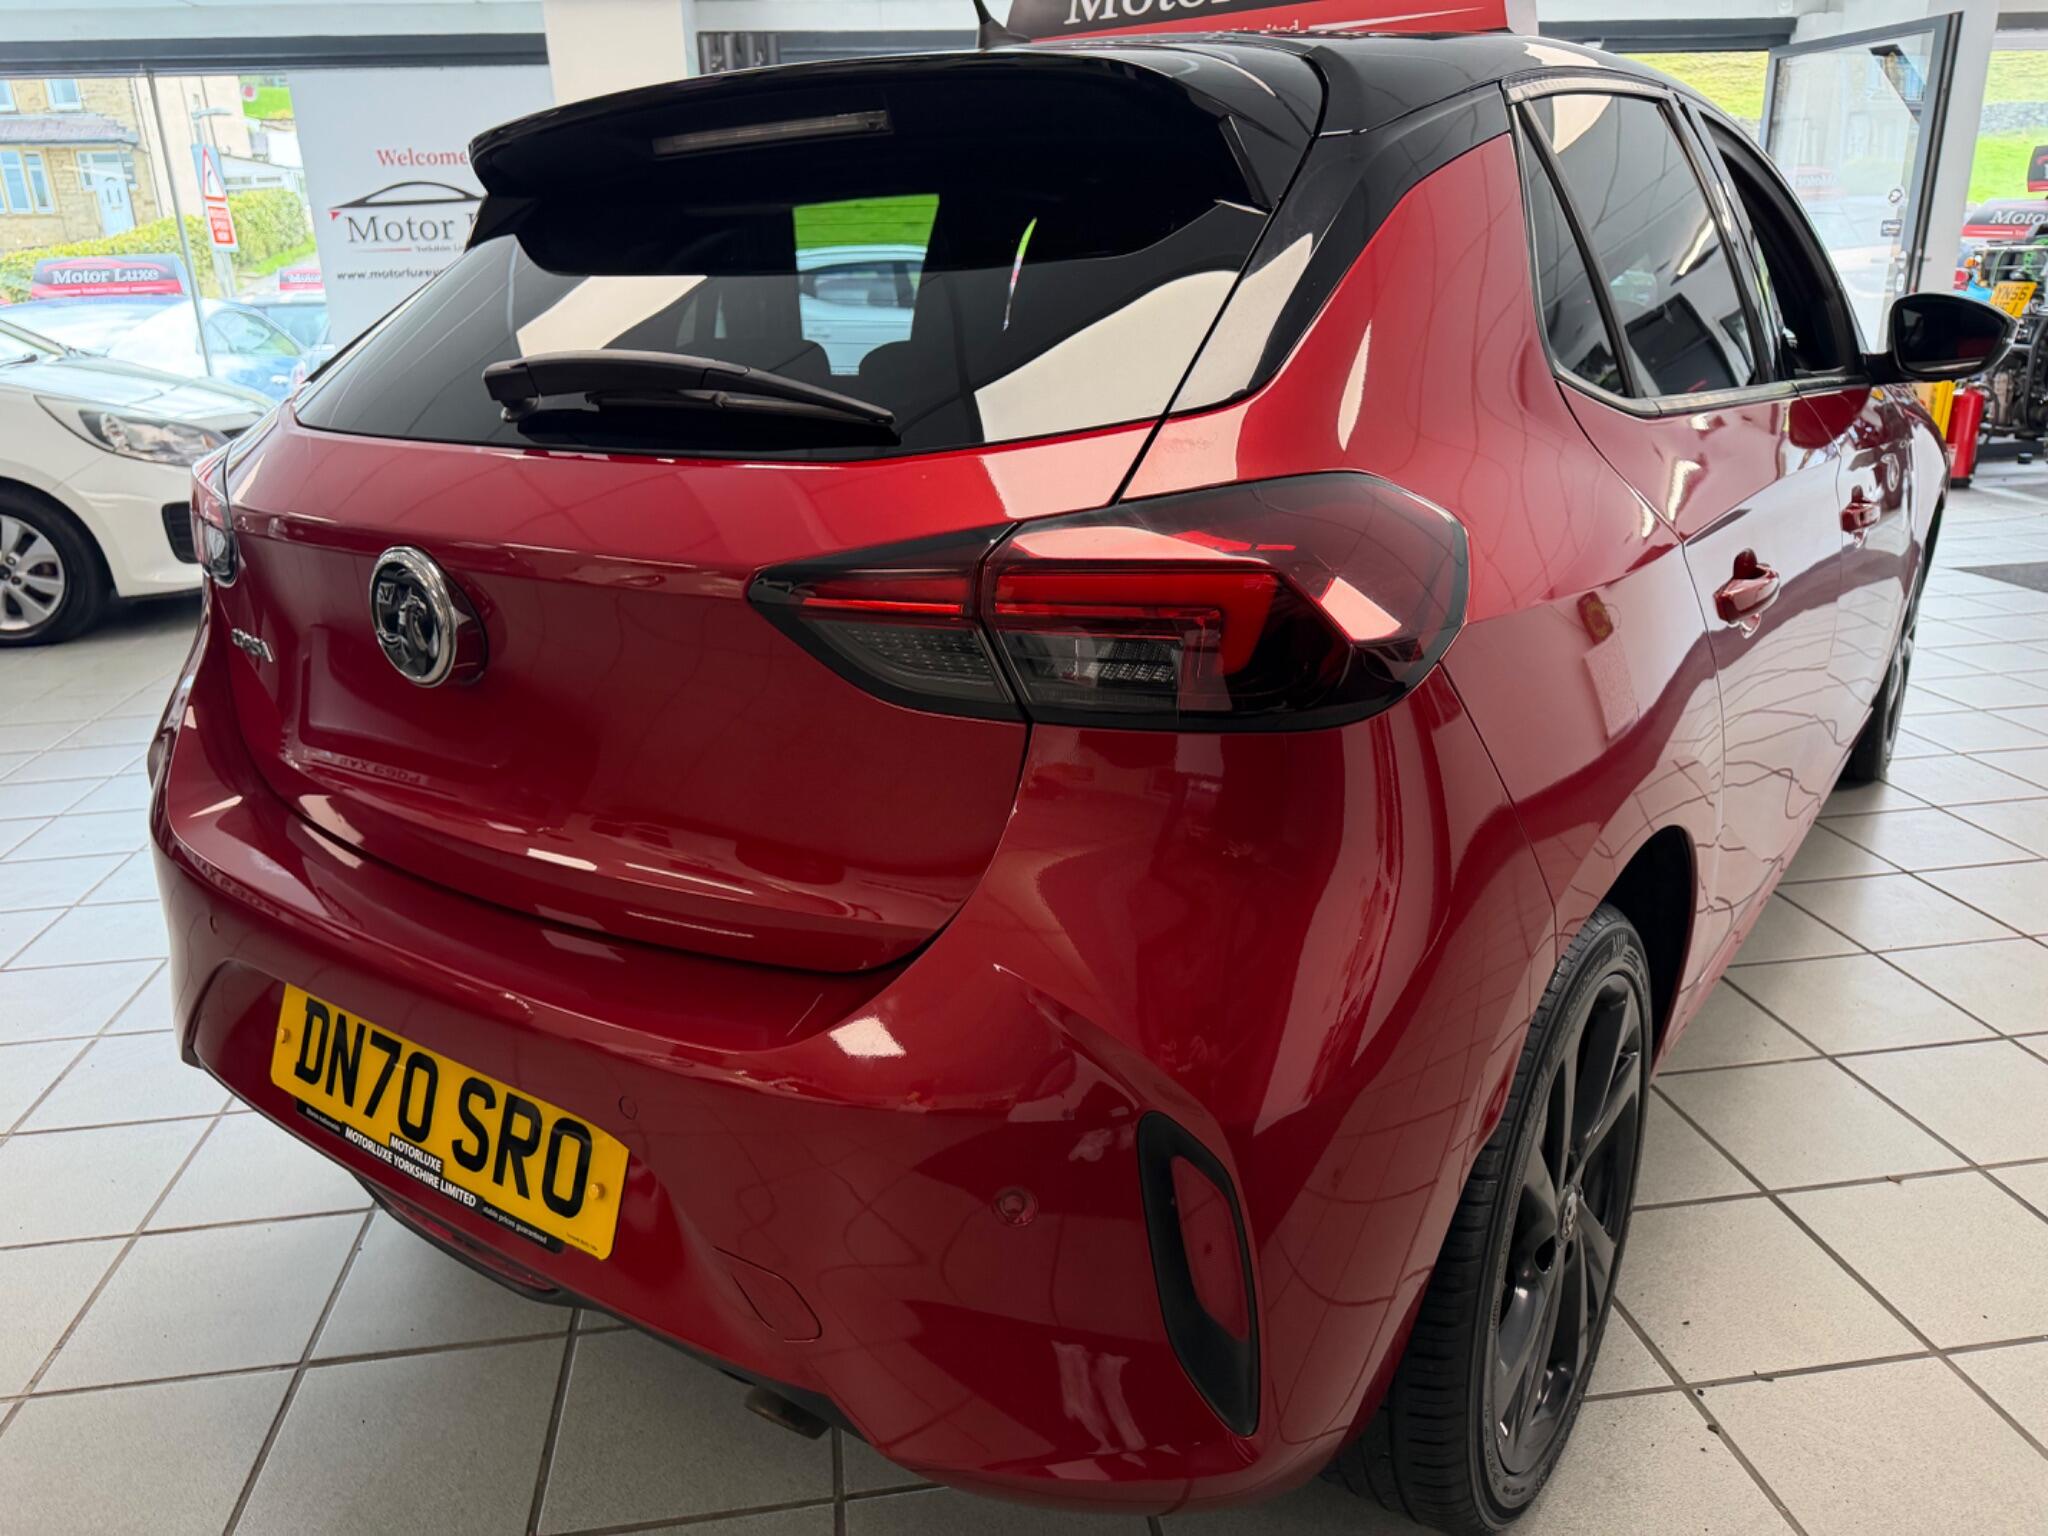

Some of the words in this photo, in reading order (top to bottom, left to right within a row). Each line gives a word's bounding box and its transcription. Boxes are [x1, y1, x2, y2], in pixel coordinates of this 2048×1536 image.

[376, 147, 468, 167] Welcome
[345, 214, 455, 243] Motor
[1989, 210, 2048, 225] Moto
[52, 269, 110, 285] Motor
[114, 268, 160, 283] Luxe
[294, 996, 439, 1144] DN70
[452, 1076, 593, 1219] SRO
[344, 1126, 393, 1164] MOTORLUXE
[393, 1154, 440, 1189] YORKSHIRE
[440, 1178, 477, 1208] LIMITED
[390, 1135, 443, 1173] MOTORLUXE
